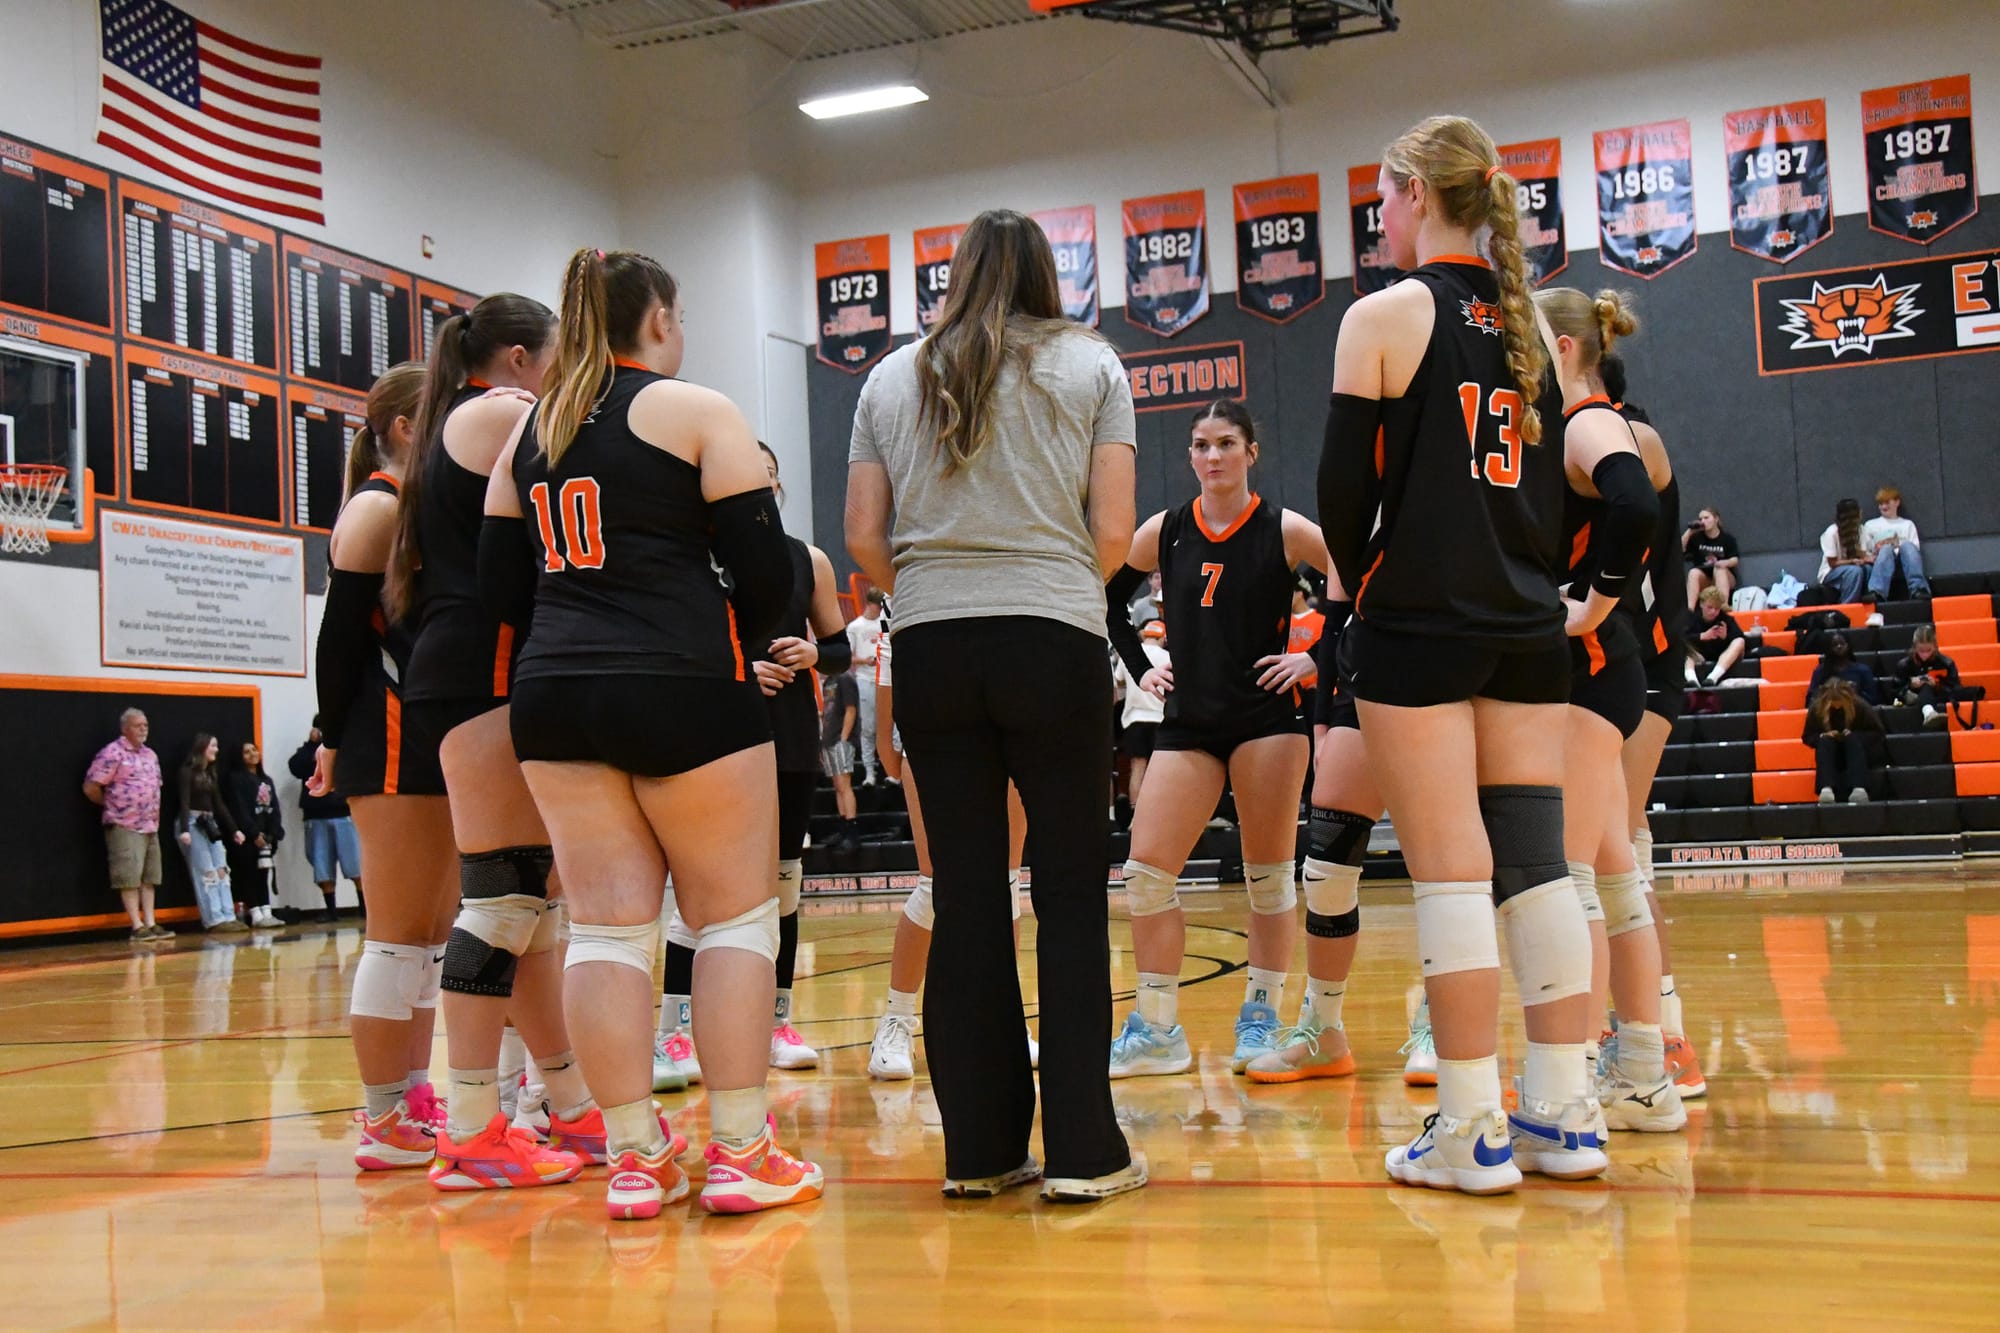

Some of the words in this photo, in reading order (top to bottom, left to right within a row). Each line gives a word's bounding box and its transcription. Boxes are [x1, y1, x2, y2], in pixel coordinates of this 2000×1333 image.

[1883, 124, 1951, 161] 1987
[1744, 145, 1809, 182] 1987
[1614, 165, 1675, 199] 1986
[1876, 174, 1967, 200] CHAMPIONS
[1139, 232, 1192, 262] 1982
[1251, 216, 1305, 249] 1983
[830, 274, 878, 303] 1973
[5, 318, 39, 336] DANCE
[1126, 356, 1239, 399] ECTION
[1458, 381, 1524, 488] 13
[111, 521, 145, 537] CWAC
[530, 476, 606, 573] 10
[1201, 562, 1224, 607] 7
[1672, 848, 1742, 862] EPHRATA
[1747, 845, 1782, 860] HIGH
[1786, 843, 1843, 858] SCHOOL
[804, 878, 857, 891] EPHRATA
[860, 876, 887, 889] HIGH
[889, 875, 920, 888] SCHO
